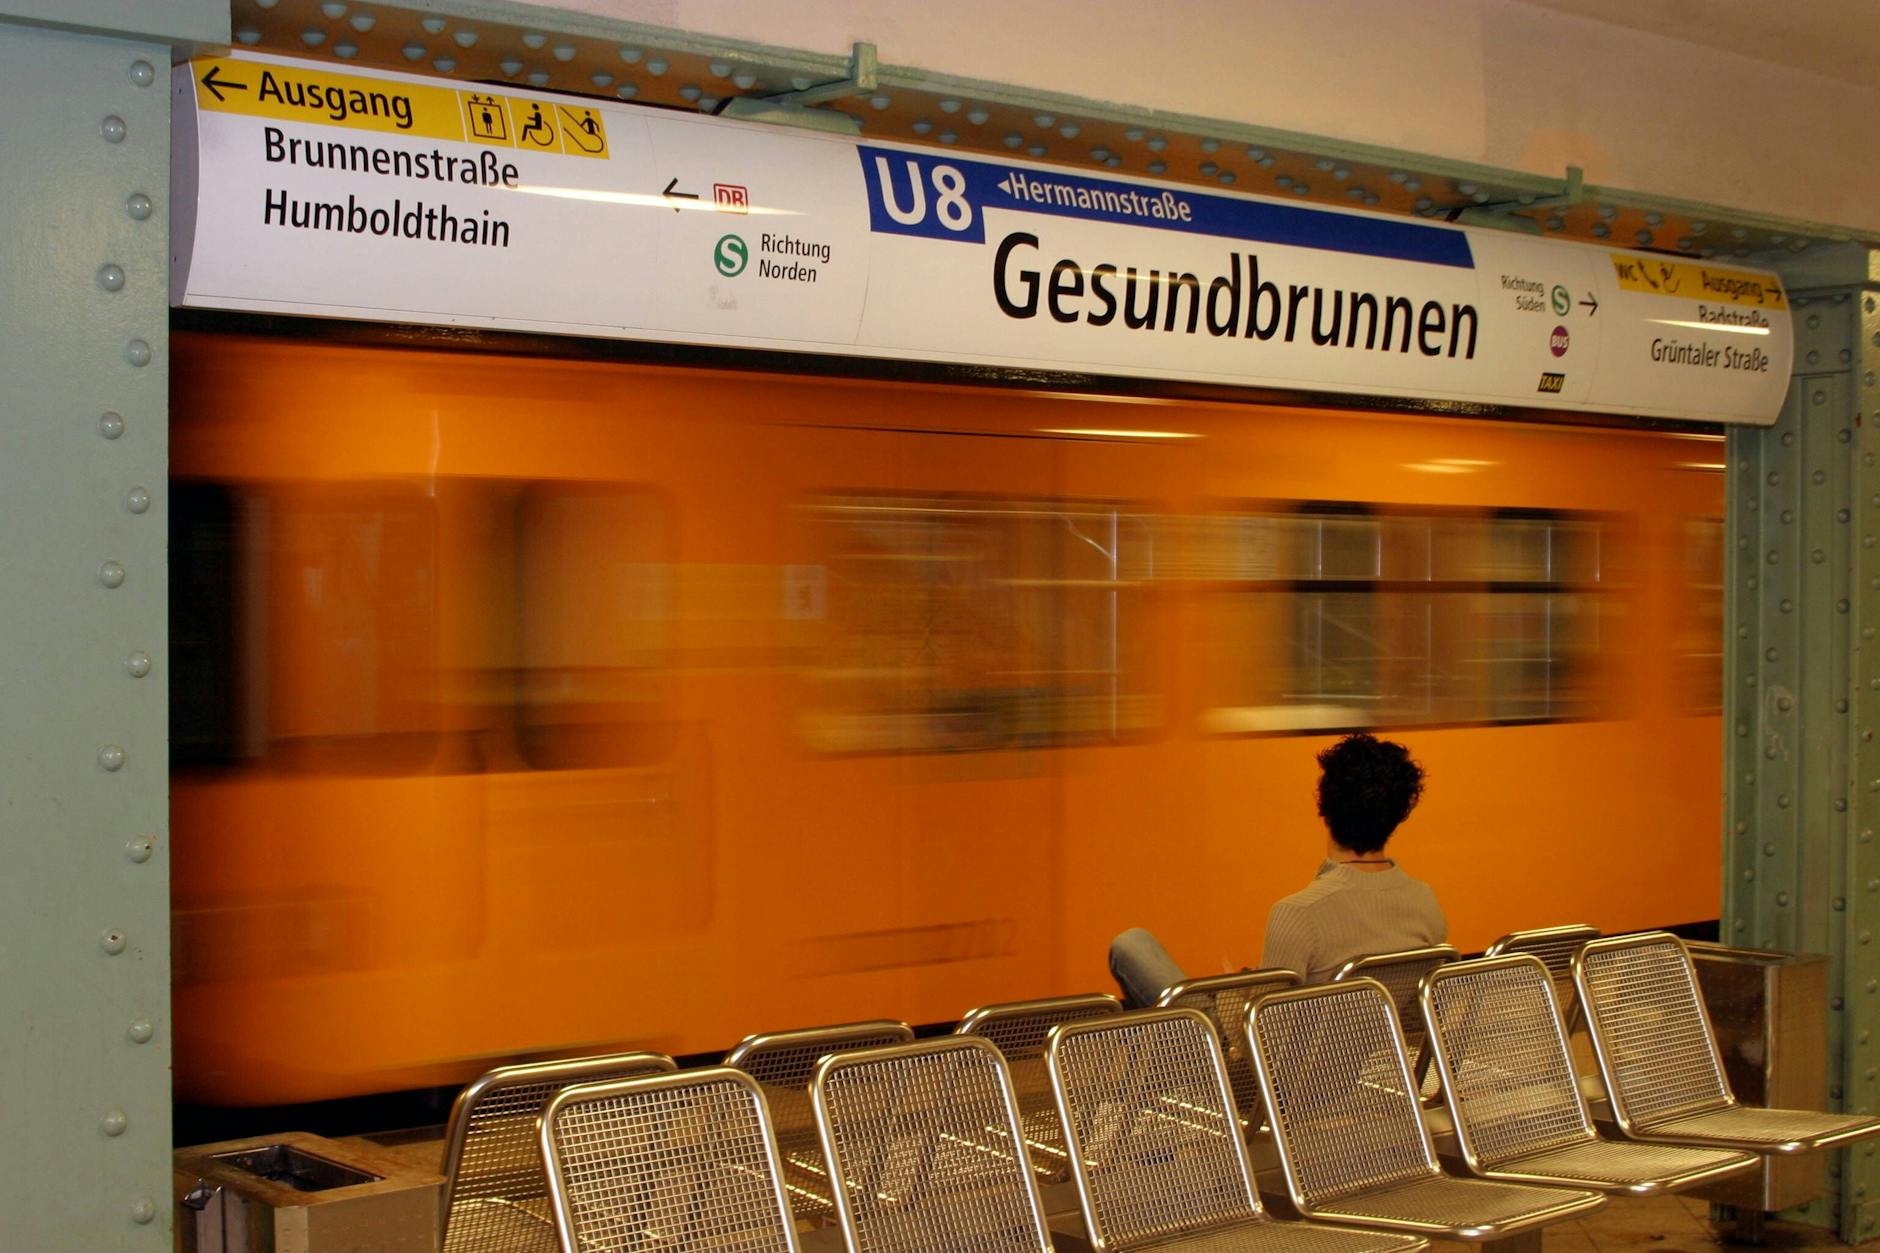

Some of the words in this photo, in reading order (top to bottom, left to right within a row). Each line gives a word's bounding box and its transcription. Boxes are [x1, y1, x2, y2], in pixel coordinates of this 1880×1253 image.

[258, 71, 413, 129] Ausgang
[264, 126, 519, 187] Brunnenstraße
[875, 157, 972, 232] U8
[1009, 172, 1193, 223] Hermannstraße
[264, 188, 511, 248] Humboldthain
[761, 233, 831, 264] Richtung
[758, 258, 818, 283] Norden
[1500, 274, 1545, 298] Richtung
[1615, 262, 1638, 282] WC
[1701, 270, 1764, 304] Ausgang
[993, 231, 1478, 360] Gesundbrunnen
[1515, 295, 1546, 313] Süden
[1551, 335, 1569, 349] BUS
[1650, 338, 1720, 369] Grüntaler
[1723, 345, 1769, 373] Straße
[1540, 374, 1564, 390] TAXI
